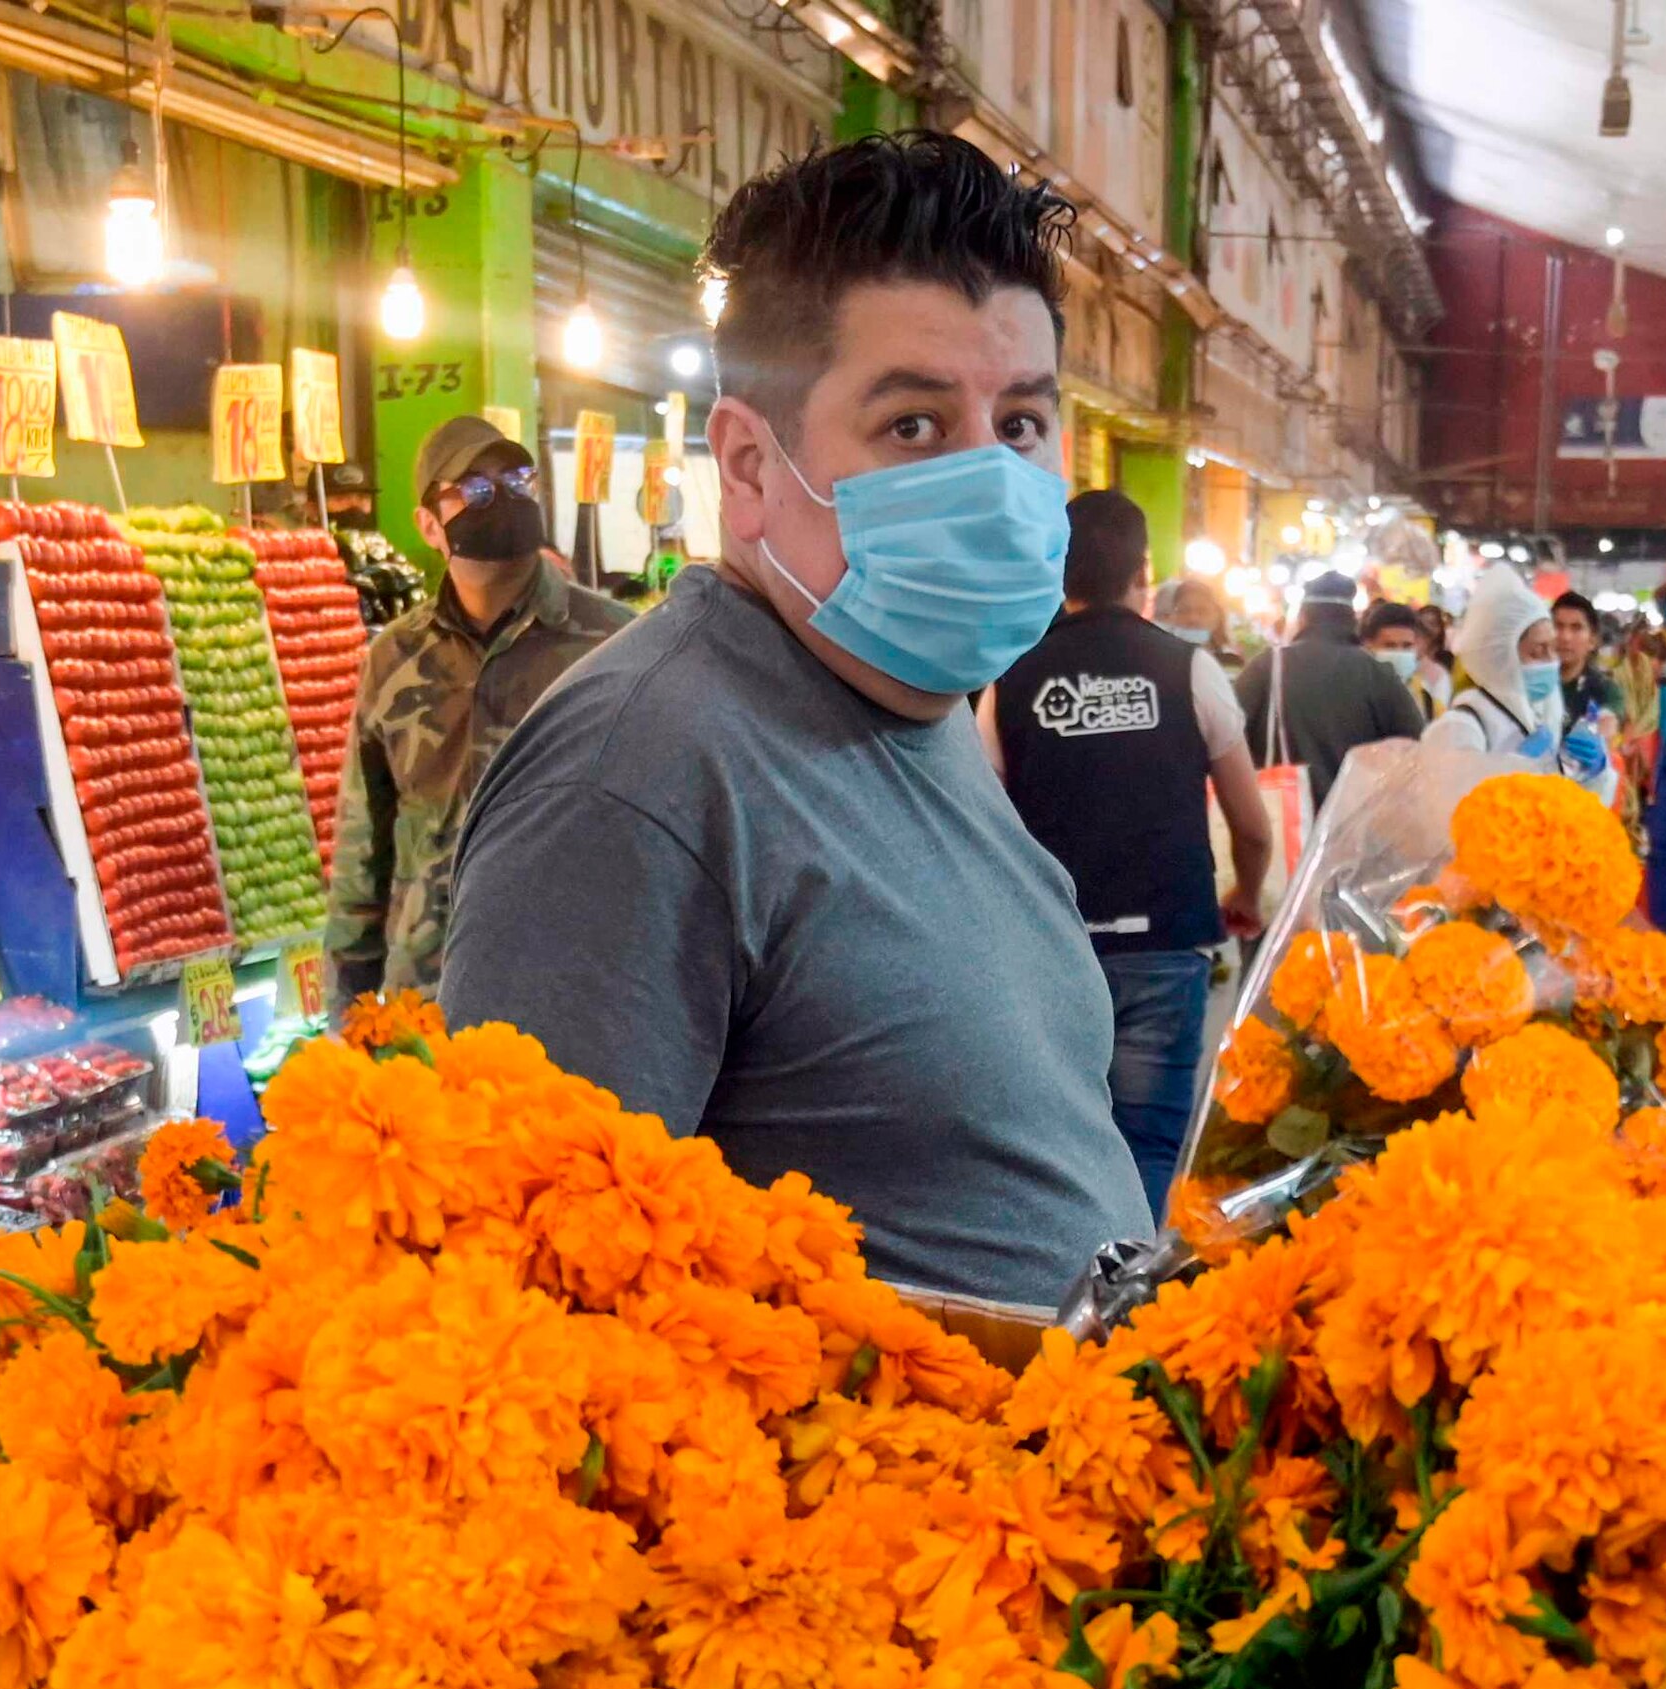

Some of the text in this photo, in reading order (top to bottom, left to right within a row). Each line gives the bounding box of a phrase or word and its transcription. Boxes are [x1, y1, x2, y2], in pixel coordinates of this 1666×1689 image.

[377, 363, 463, 401] I-73
[1080, 677, 1146, 698] MÉDICO
[1081, 701, 1152, 729] casa
